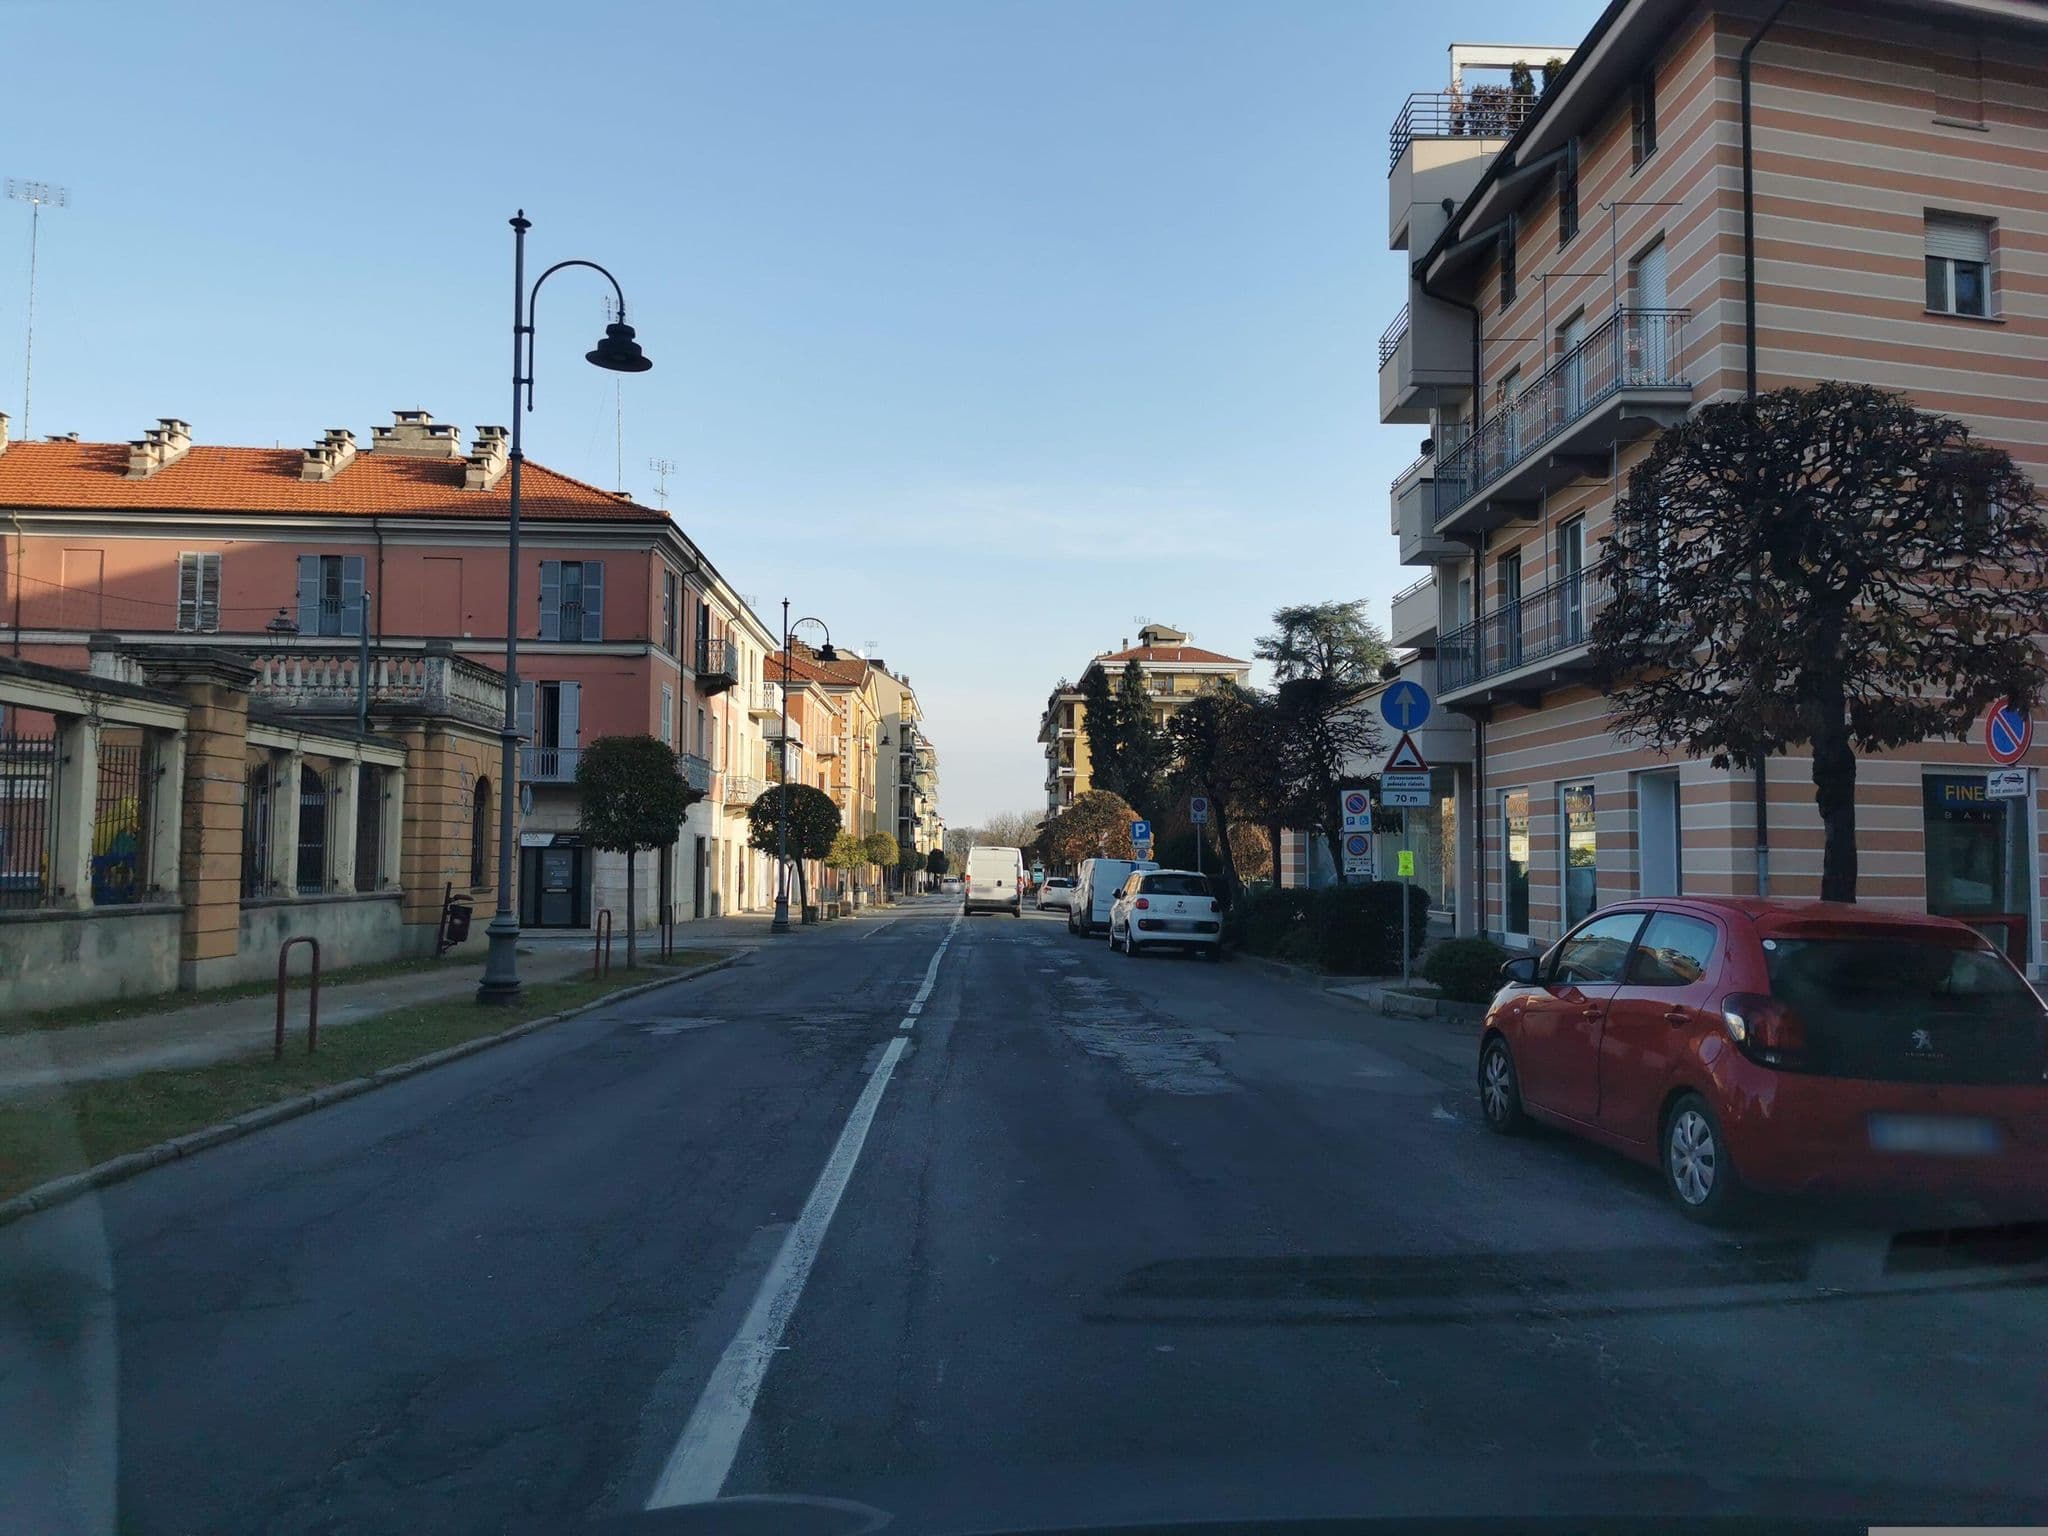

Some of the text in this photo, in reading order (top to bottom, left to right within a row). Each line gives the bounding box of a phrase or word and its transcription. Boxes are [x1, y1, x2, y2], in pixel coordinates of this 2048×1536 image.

[1395, 794, 1407, 803] 70
[1945, 785, 2001, 802] FINE
[1135, 823, 1146, 837] P
